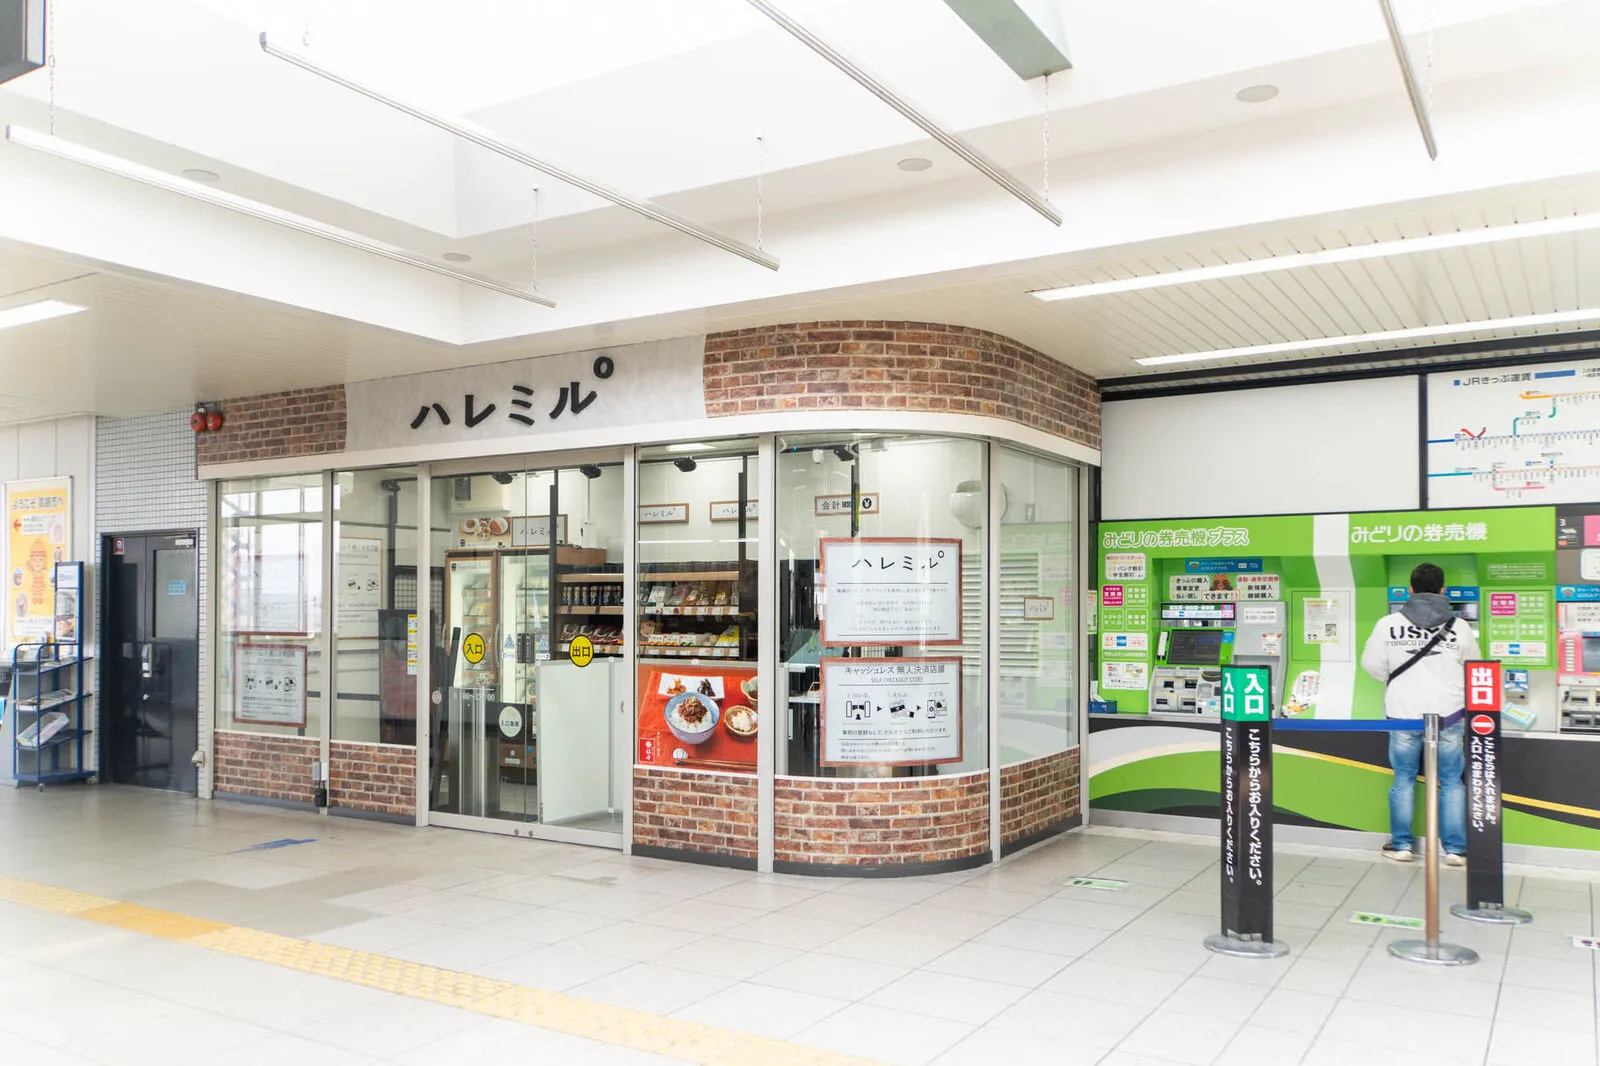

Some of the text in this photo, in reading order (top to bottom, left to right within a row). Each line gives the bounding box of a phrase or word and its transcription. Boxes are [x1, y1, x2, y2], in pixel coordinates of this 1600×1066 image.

[1351, 521, 1487, 544] みどりの券売機
[465, 643, 483, 655] 入口
[571, 646, 591, 657] 出口
[844, 664, 945, 675] キャッシュレス 無人決済店舗
[1471, 667, 1493, 705] 出口
[1223, 672, 1235, 714] 入口
[1243, 672, 1265, 715] 入口
[1225, 727, 1234, 884] こちらからお入りください。
[1248, 728, 1262, 886] こちらからお入りください。
